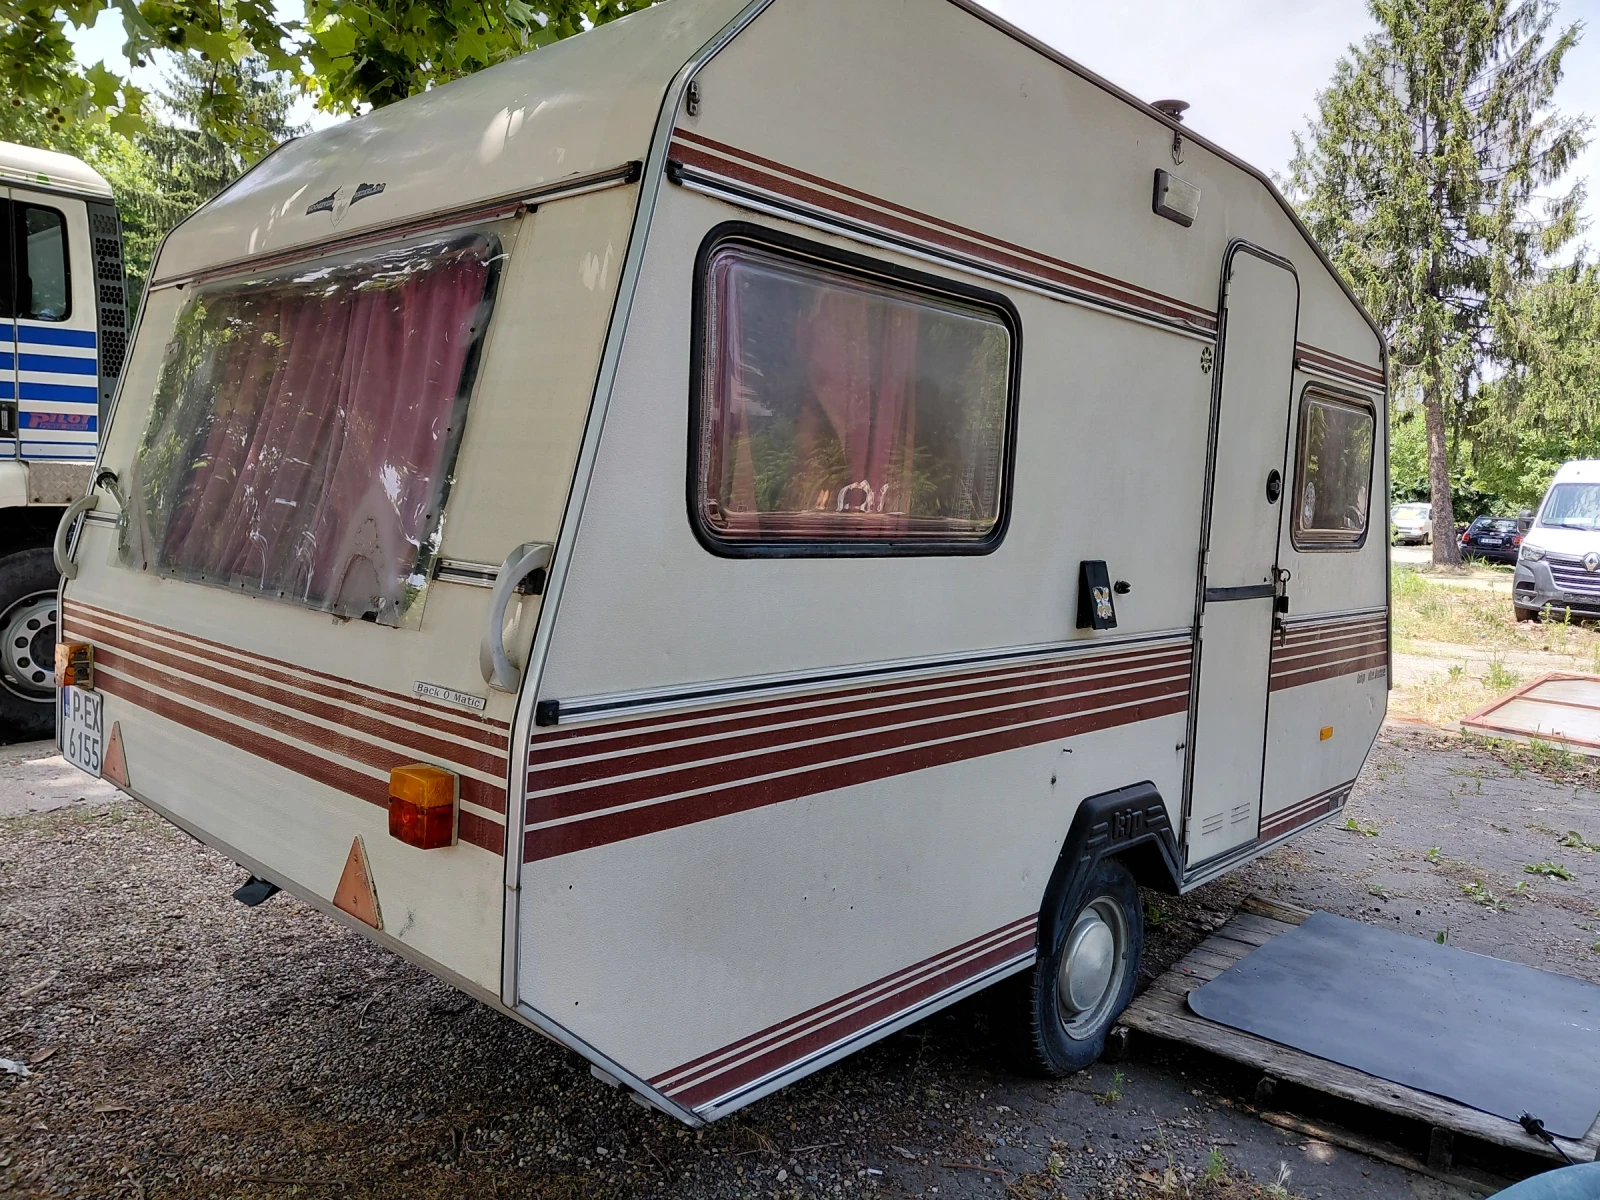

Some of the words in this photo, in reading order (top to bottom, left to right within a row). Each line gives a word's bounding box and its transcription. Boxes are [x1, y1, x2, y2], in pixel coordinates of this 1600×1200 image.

[417, 683, 440, 697] Back
[443, 690, 450, 701] O
[453, 693, 481, 708] Matic
[69, 727, 99, 771] 6155
[1112, 808, 1143, 840] kip
